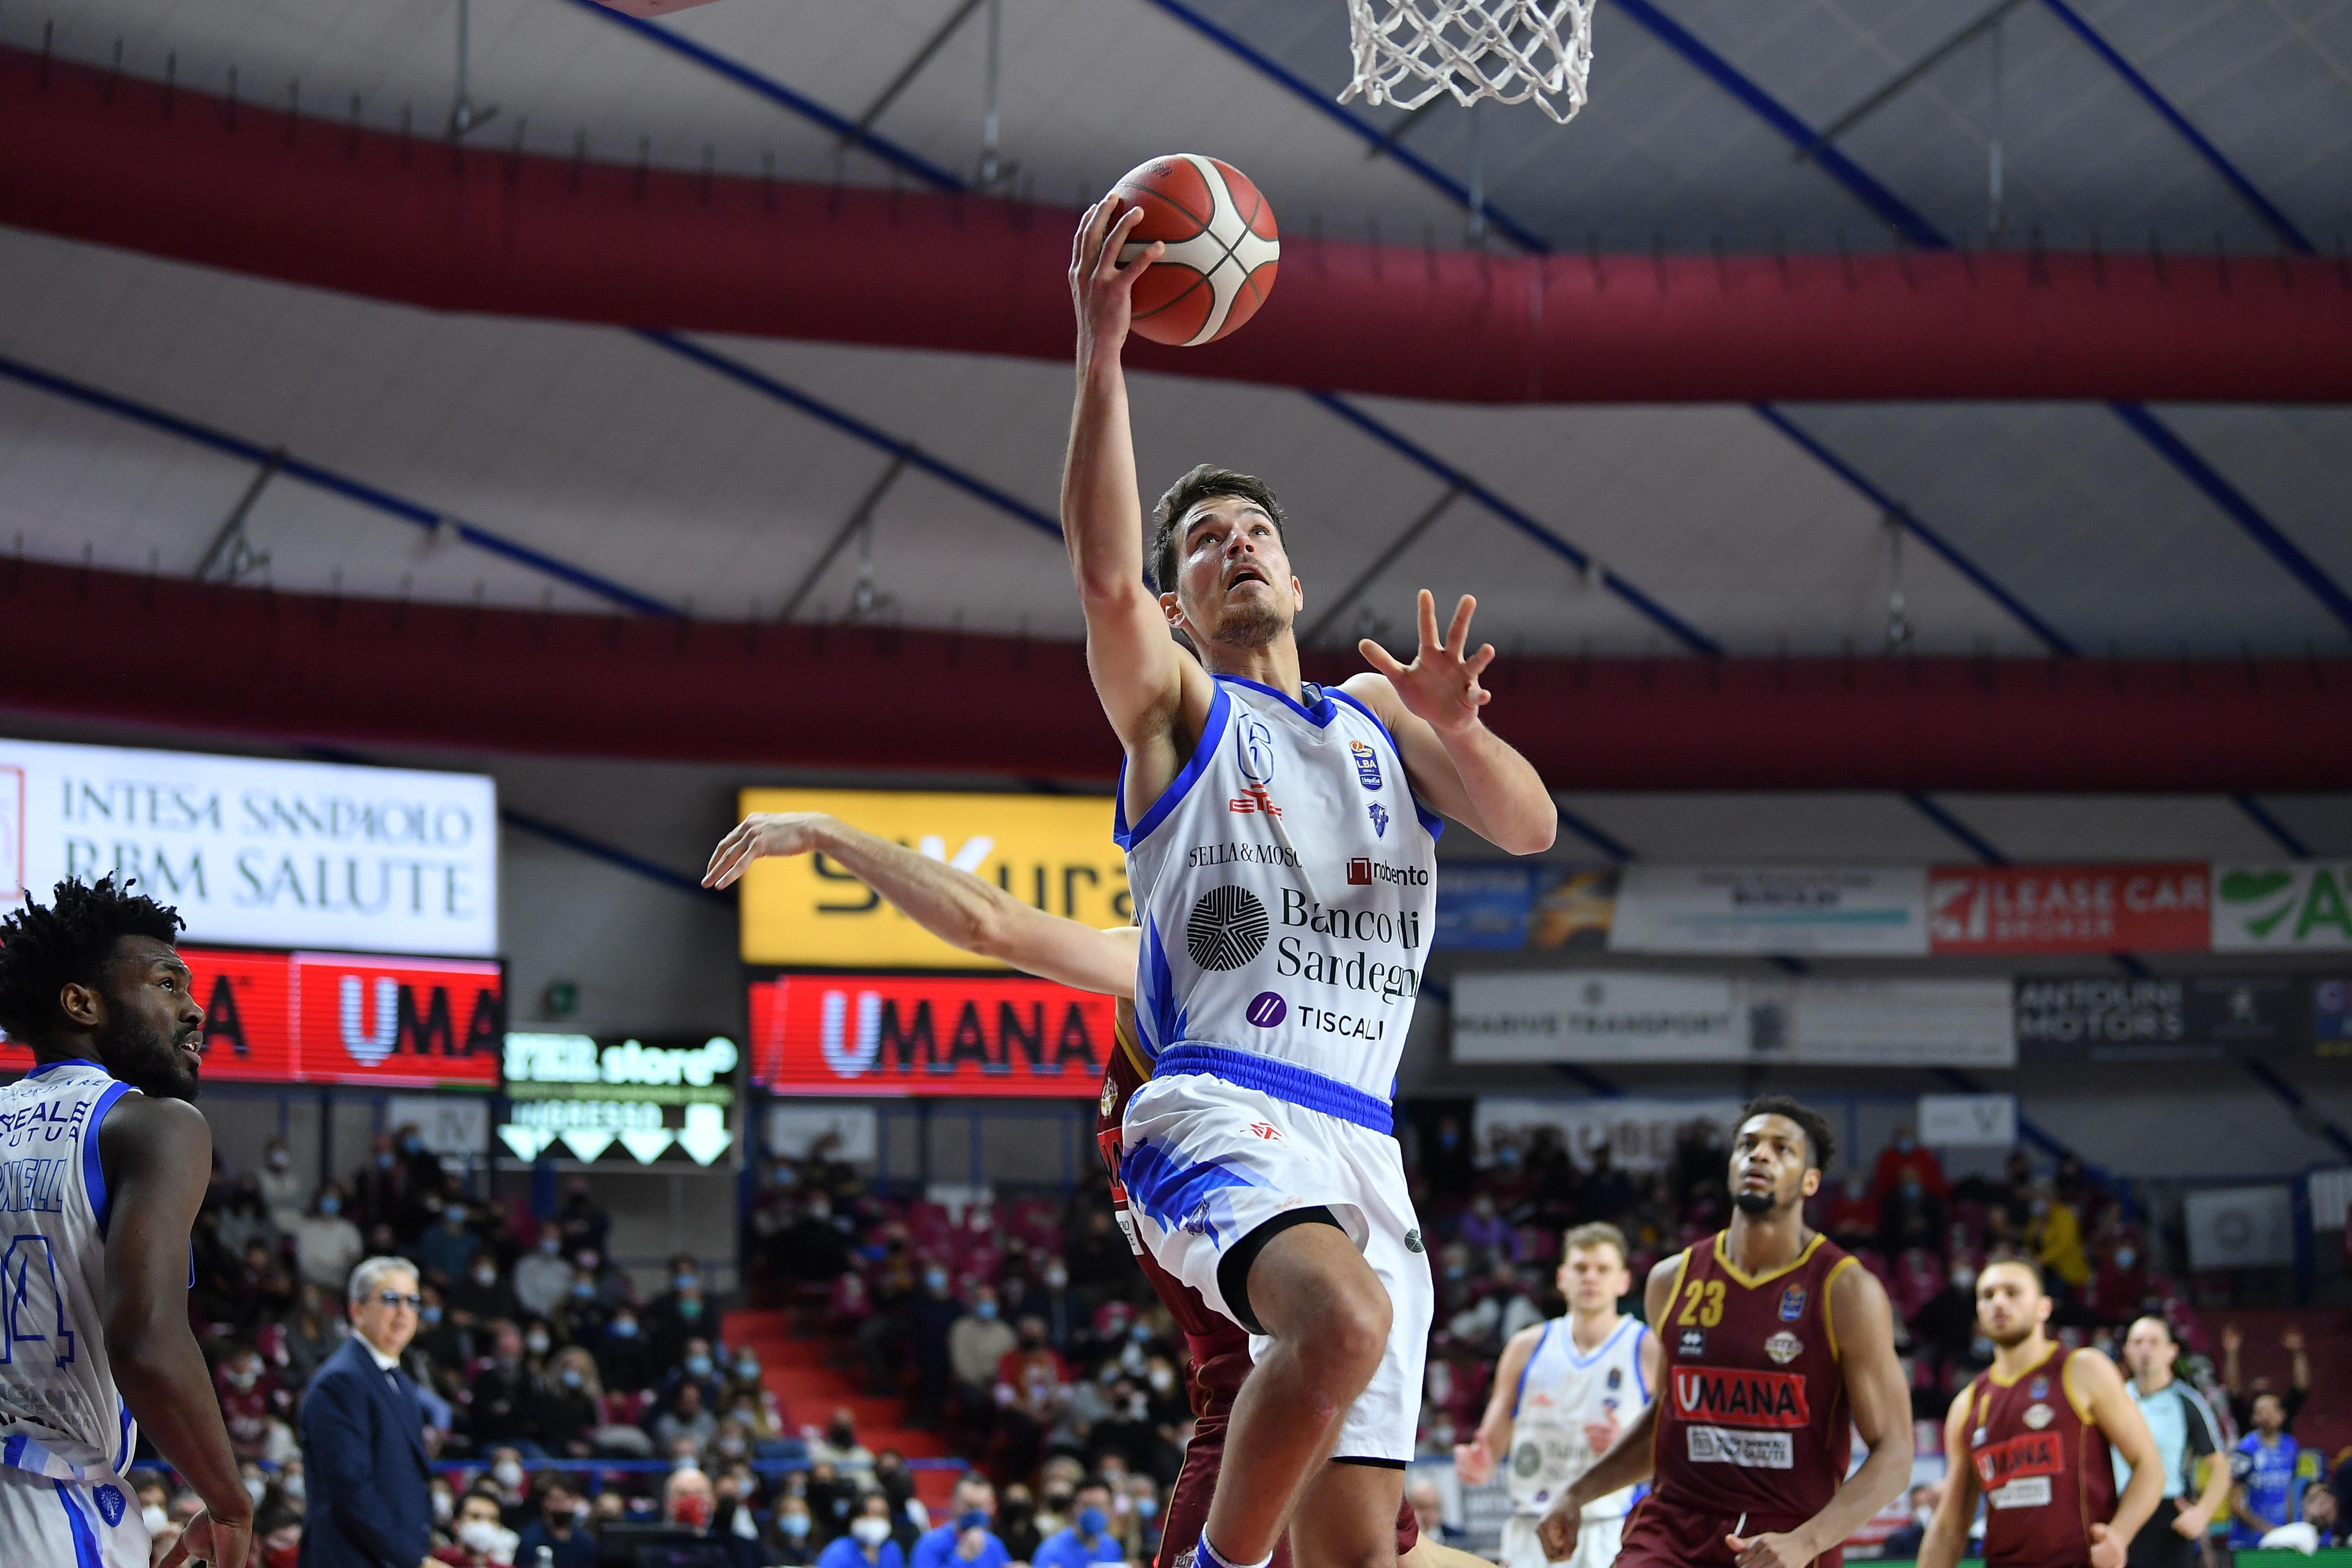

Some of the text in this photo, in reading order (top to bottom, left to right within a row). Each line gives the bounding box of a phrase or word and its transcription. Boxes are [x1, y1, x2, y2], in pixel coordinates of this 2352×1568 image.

[1356, 760, 1377, 769] LBA
[62, 775, 474, 852] INTESA SANPAOLO
[235, 851, 474, 920] SALUTE
[1373, 860, 1429, 886] nobento
[1993, 874, 2207, 914] LEASE CAR
[1280, 887, 1392, 944] Banco
[1277, 936, 1419, 1005] Sardegn
[820, 990, 1102, 1079] UMANA
[1298, 1005, 1384, 1041] TISCALI
[2018, 1008, 2184, 1040] MOTORS
[1676, 1279, 1727, 1328] 23
[1678, 1374, 1799, 1418] UMANA
